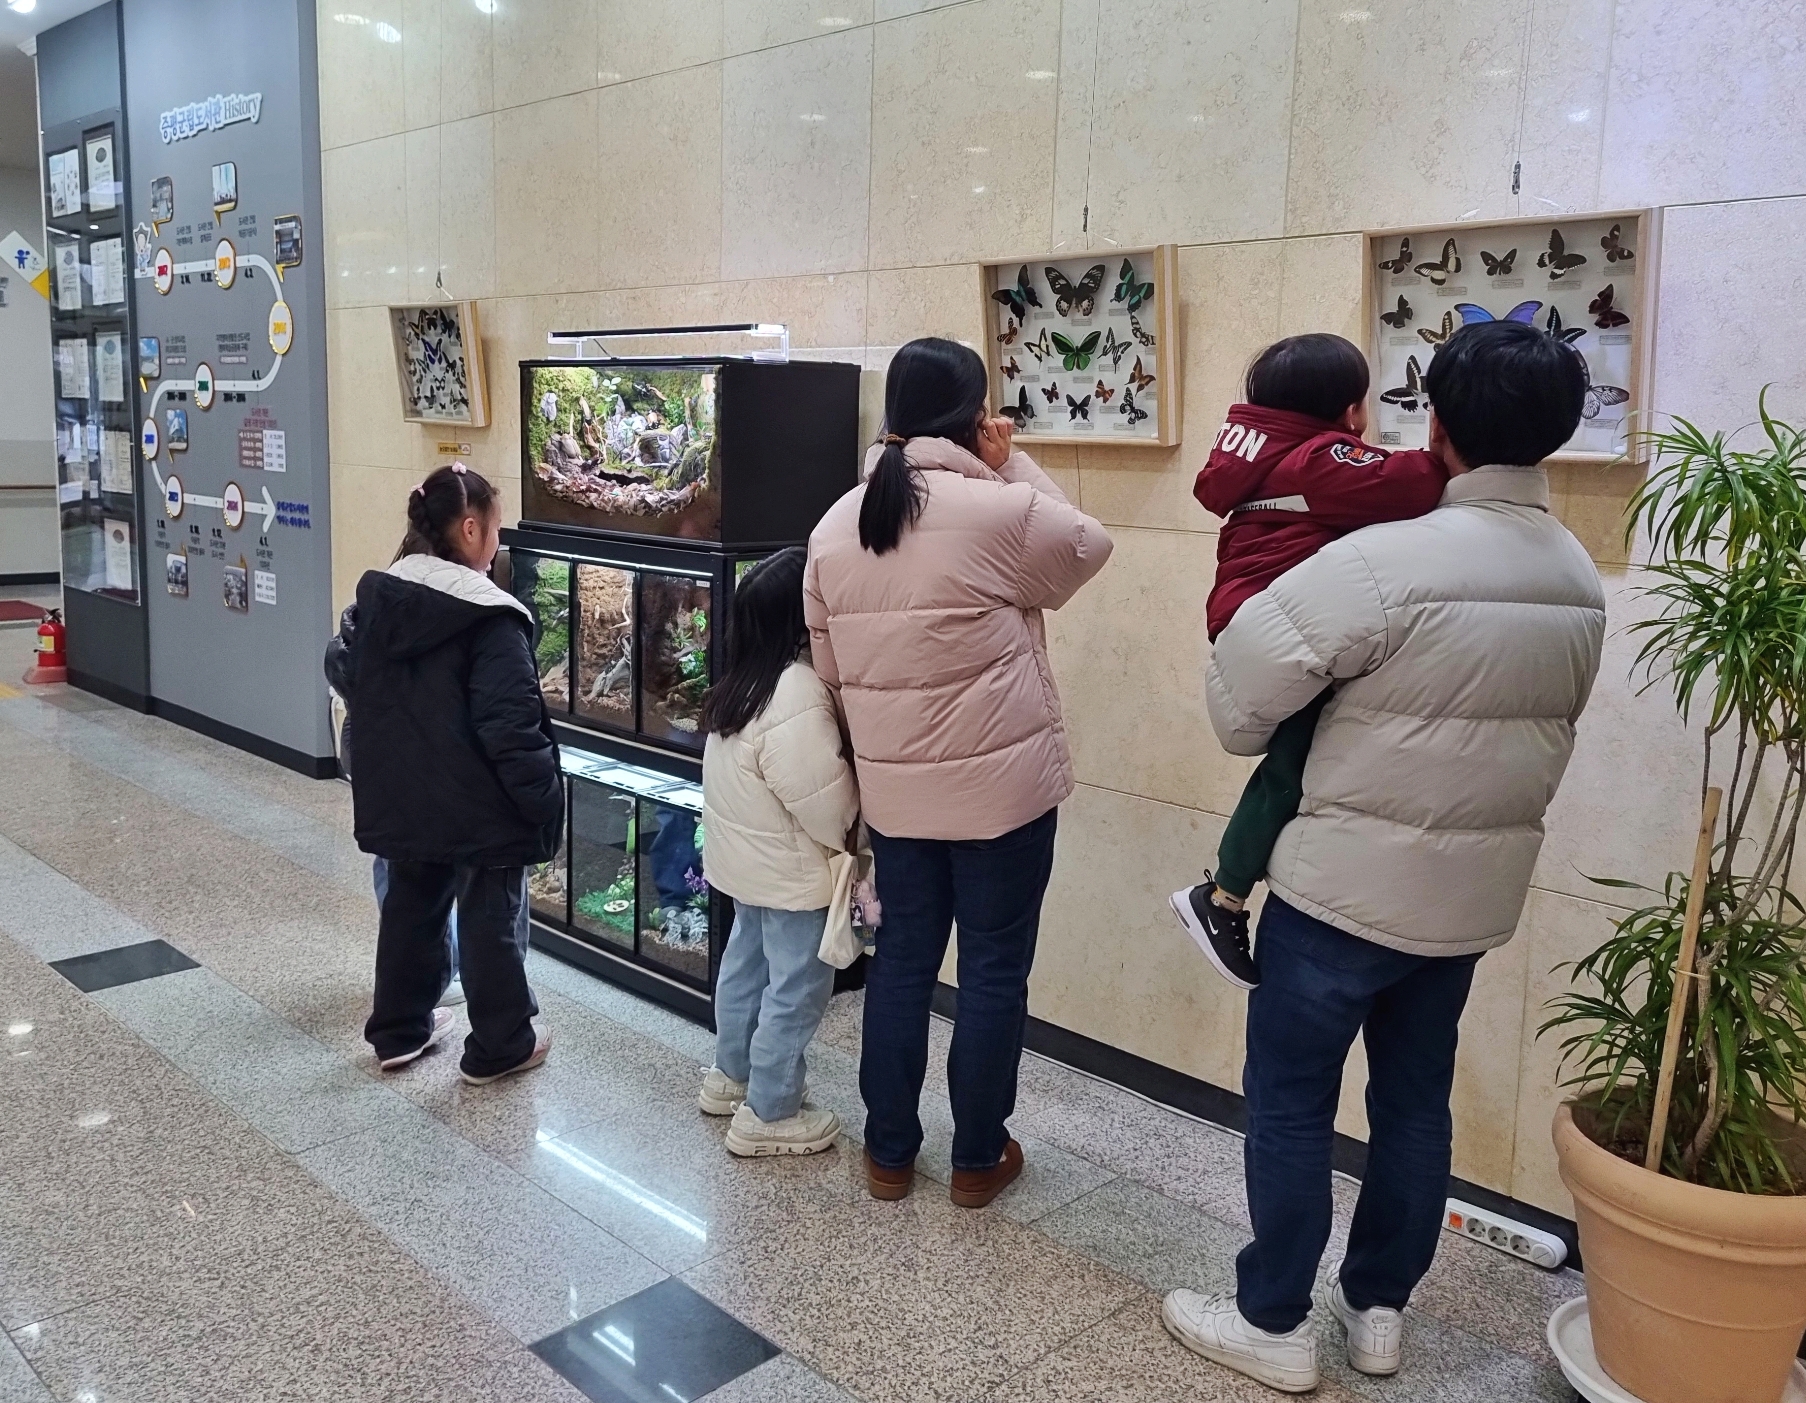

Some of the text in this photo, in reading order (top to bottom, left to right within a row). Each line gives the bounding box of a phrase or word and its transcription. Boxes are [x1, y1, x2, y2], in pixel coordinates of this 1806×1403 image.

[161, 96, 259, 139] 증평군립도서관 History
[1213, 423, 1268, 462] TON
[752, 1145, 815, 1156] FILA
